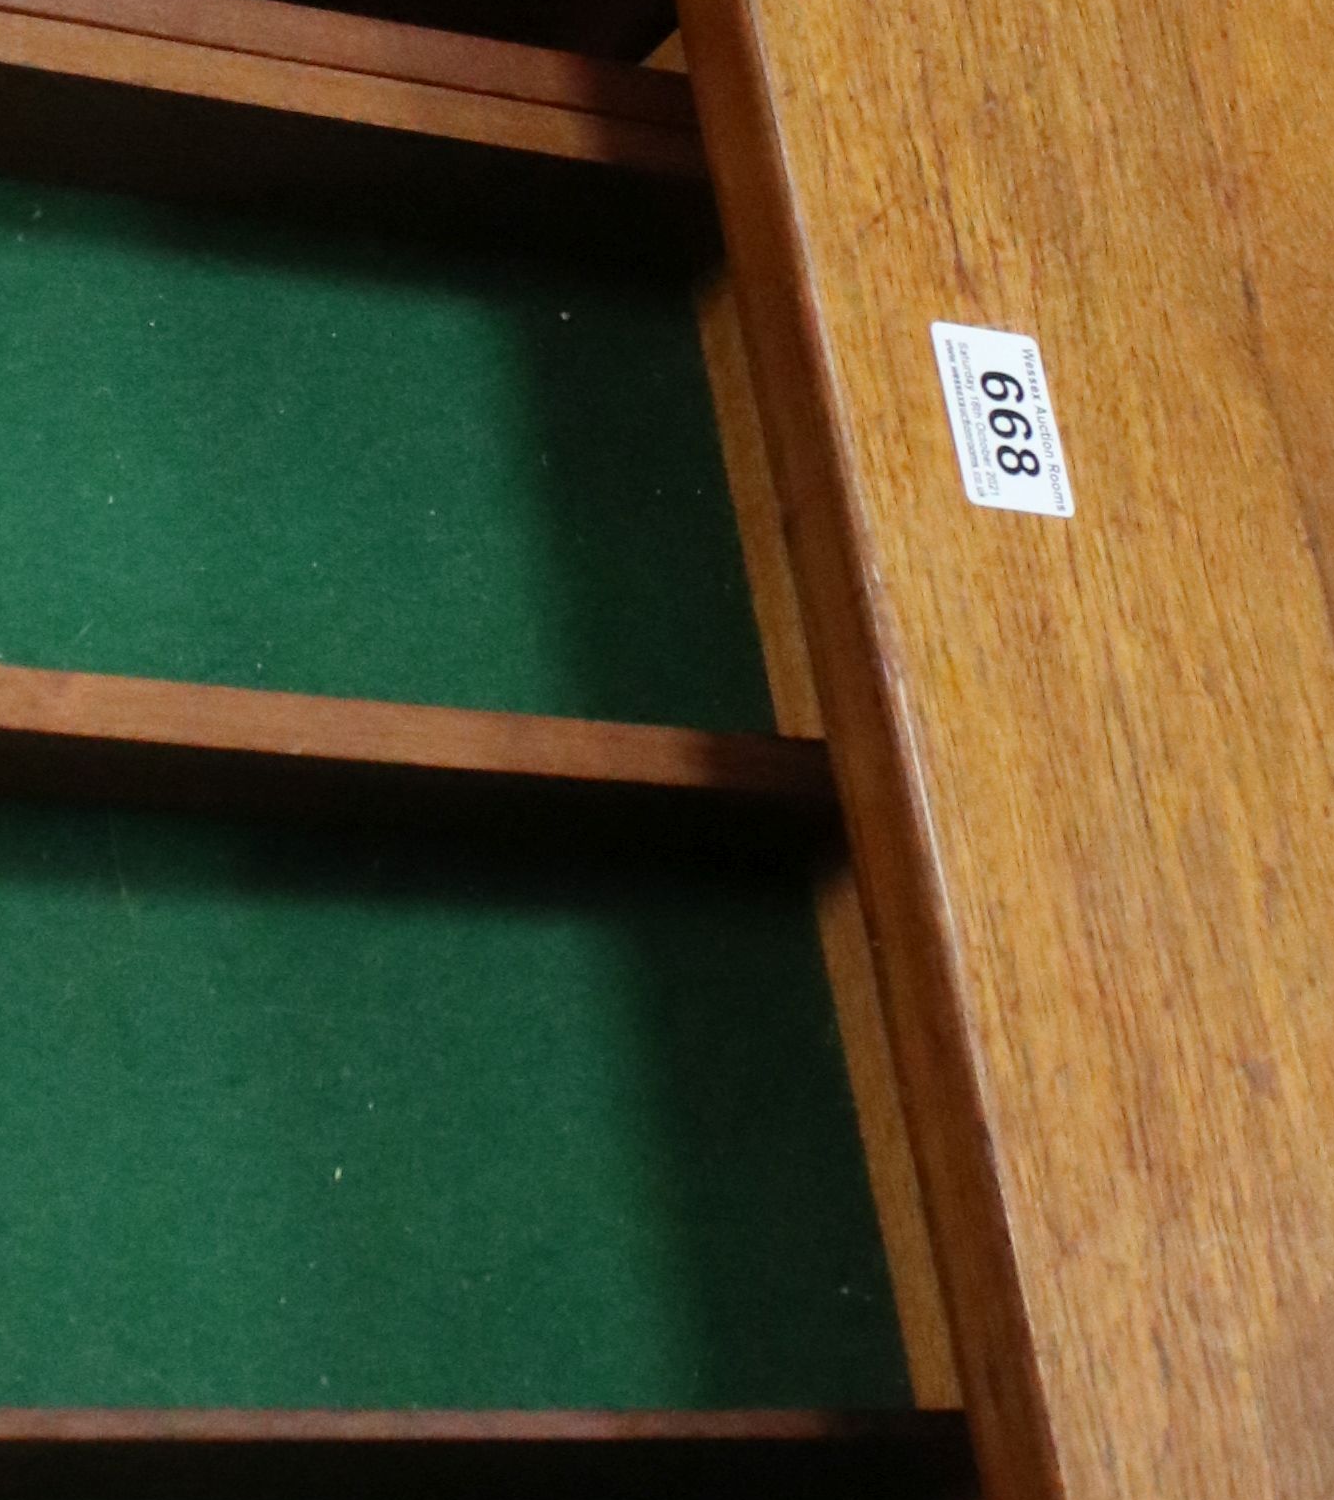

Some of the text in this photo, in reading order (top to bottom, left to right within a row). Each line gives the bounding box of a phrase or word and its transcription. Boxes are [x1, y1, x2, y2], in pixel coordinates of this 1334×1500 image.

[956, 341, 976, 391] Saturday
[980, 370, 1041, 478] 668
[1021, 348, 1067, 512] Wessex Auction Rooms
